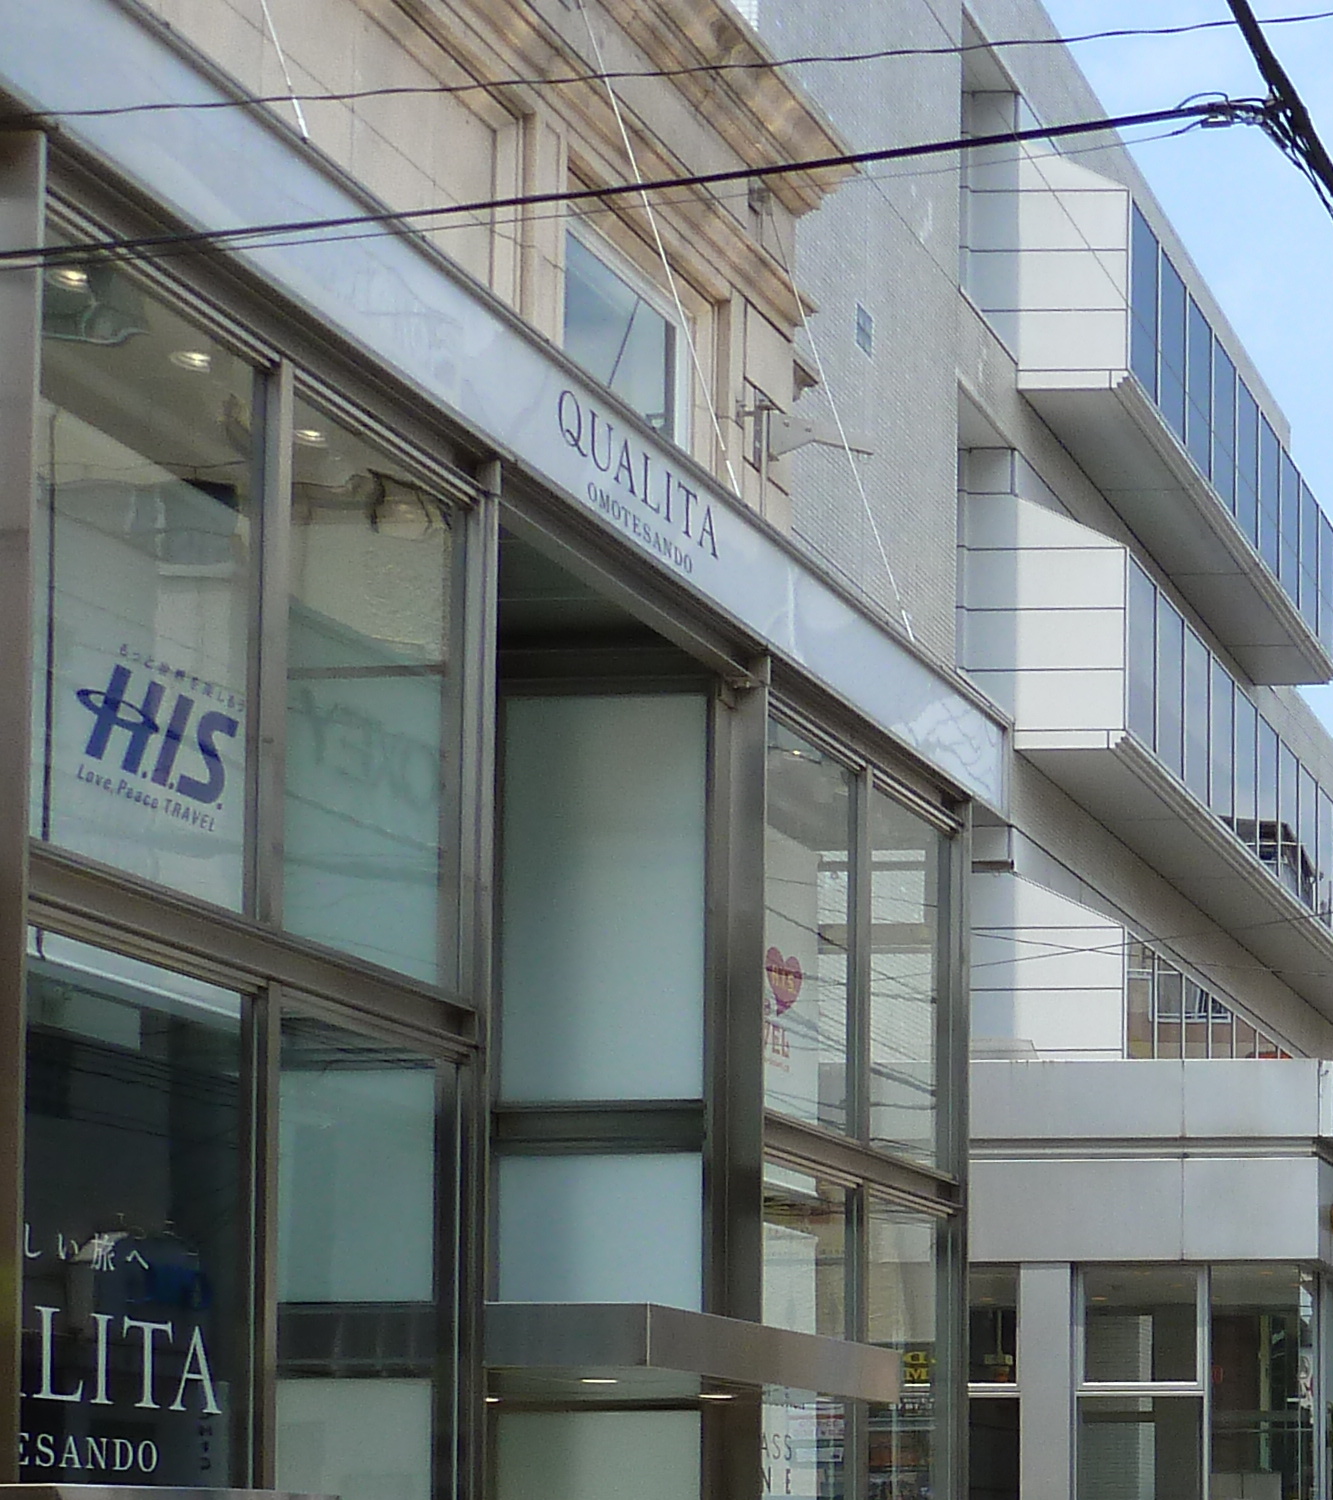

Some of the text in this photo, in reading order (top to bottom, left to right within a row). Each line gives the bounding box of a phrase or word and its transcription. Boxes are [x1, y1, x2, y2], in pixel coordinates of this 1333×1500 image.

[559, 390, 719, 561] QUALITA
[587, 481, 694, 574] OMOTESANDO
[116, 779, 159, 811] Peace
[164, 799, 216, 833] TRAVEL
[20, 1304, 223, 1415] LITA
